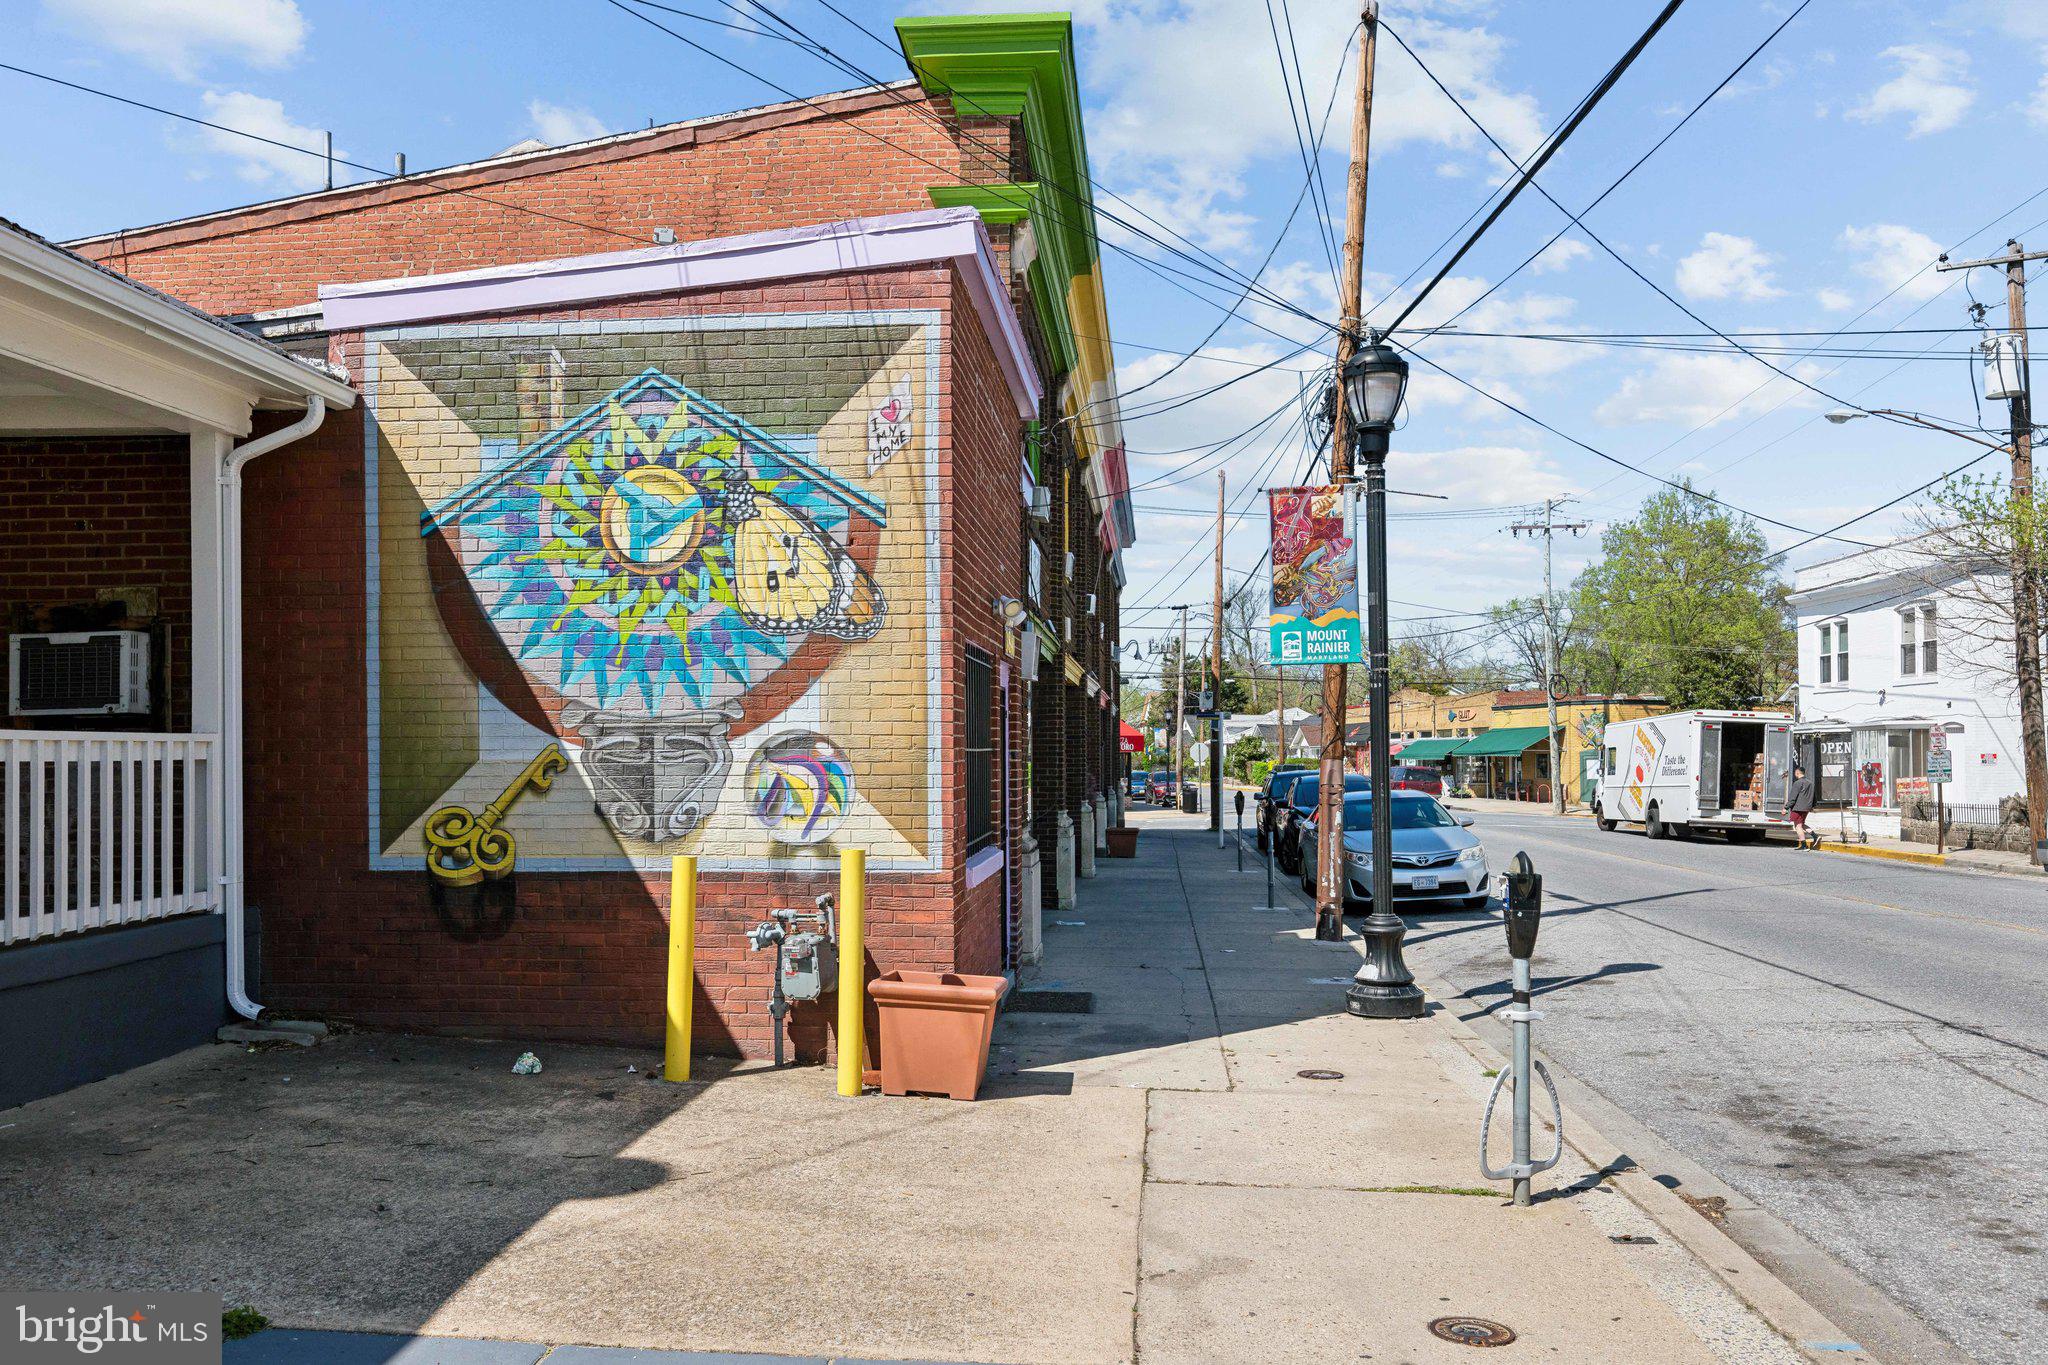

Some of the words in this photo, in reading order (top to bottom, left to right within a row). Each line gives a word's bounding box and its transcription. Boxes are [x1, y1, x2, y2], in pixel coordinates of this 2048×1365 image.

[870, 417, 880, 432] I
[876, 425, 897, 443] MY
[872, 430, 909, 464] HOME
[1307, 630, 1347, 641] MOUNT
[1307, 642, 1350, 653] RAINIER
[1821, 742, 1852, 754] OPEN
[1664, 755, 1677, 765] Taste
[1678, 755, 1686, 765] the
[1661, 765, 1688, 776] Difference!
